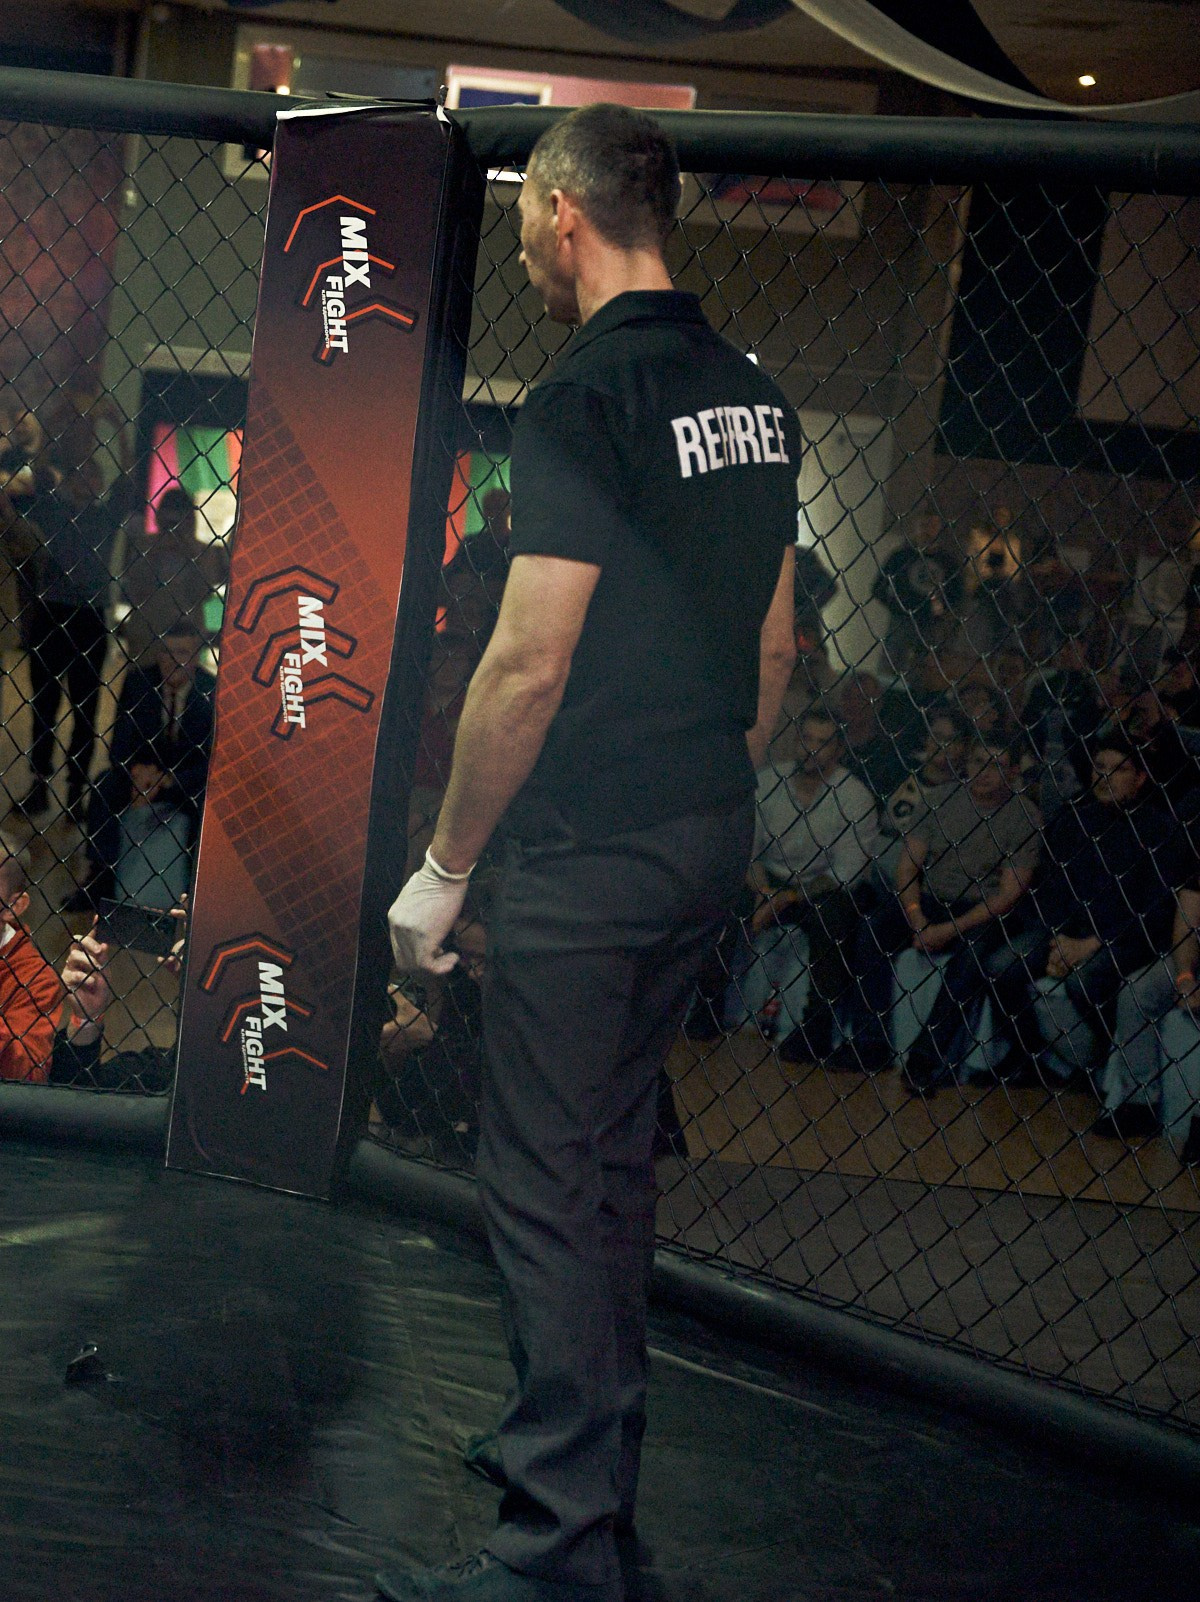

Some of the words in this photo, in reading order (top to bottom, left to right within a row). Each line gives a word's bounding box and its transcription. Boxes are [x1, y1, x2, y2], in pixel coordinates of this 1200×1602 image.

[340, 216, 370, 288] MIX
[326, 276, 348, 354] FIGHT
[298, 596, 328, 667] MIX
[284, 652, 306, 728] FIGHT
[258, 962, 288, 1032] MIX
[245, 1016, 266, 1090] FIGHT
